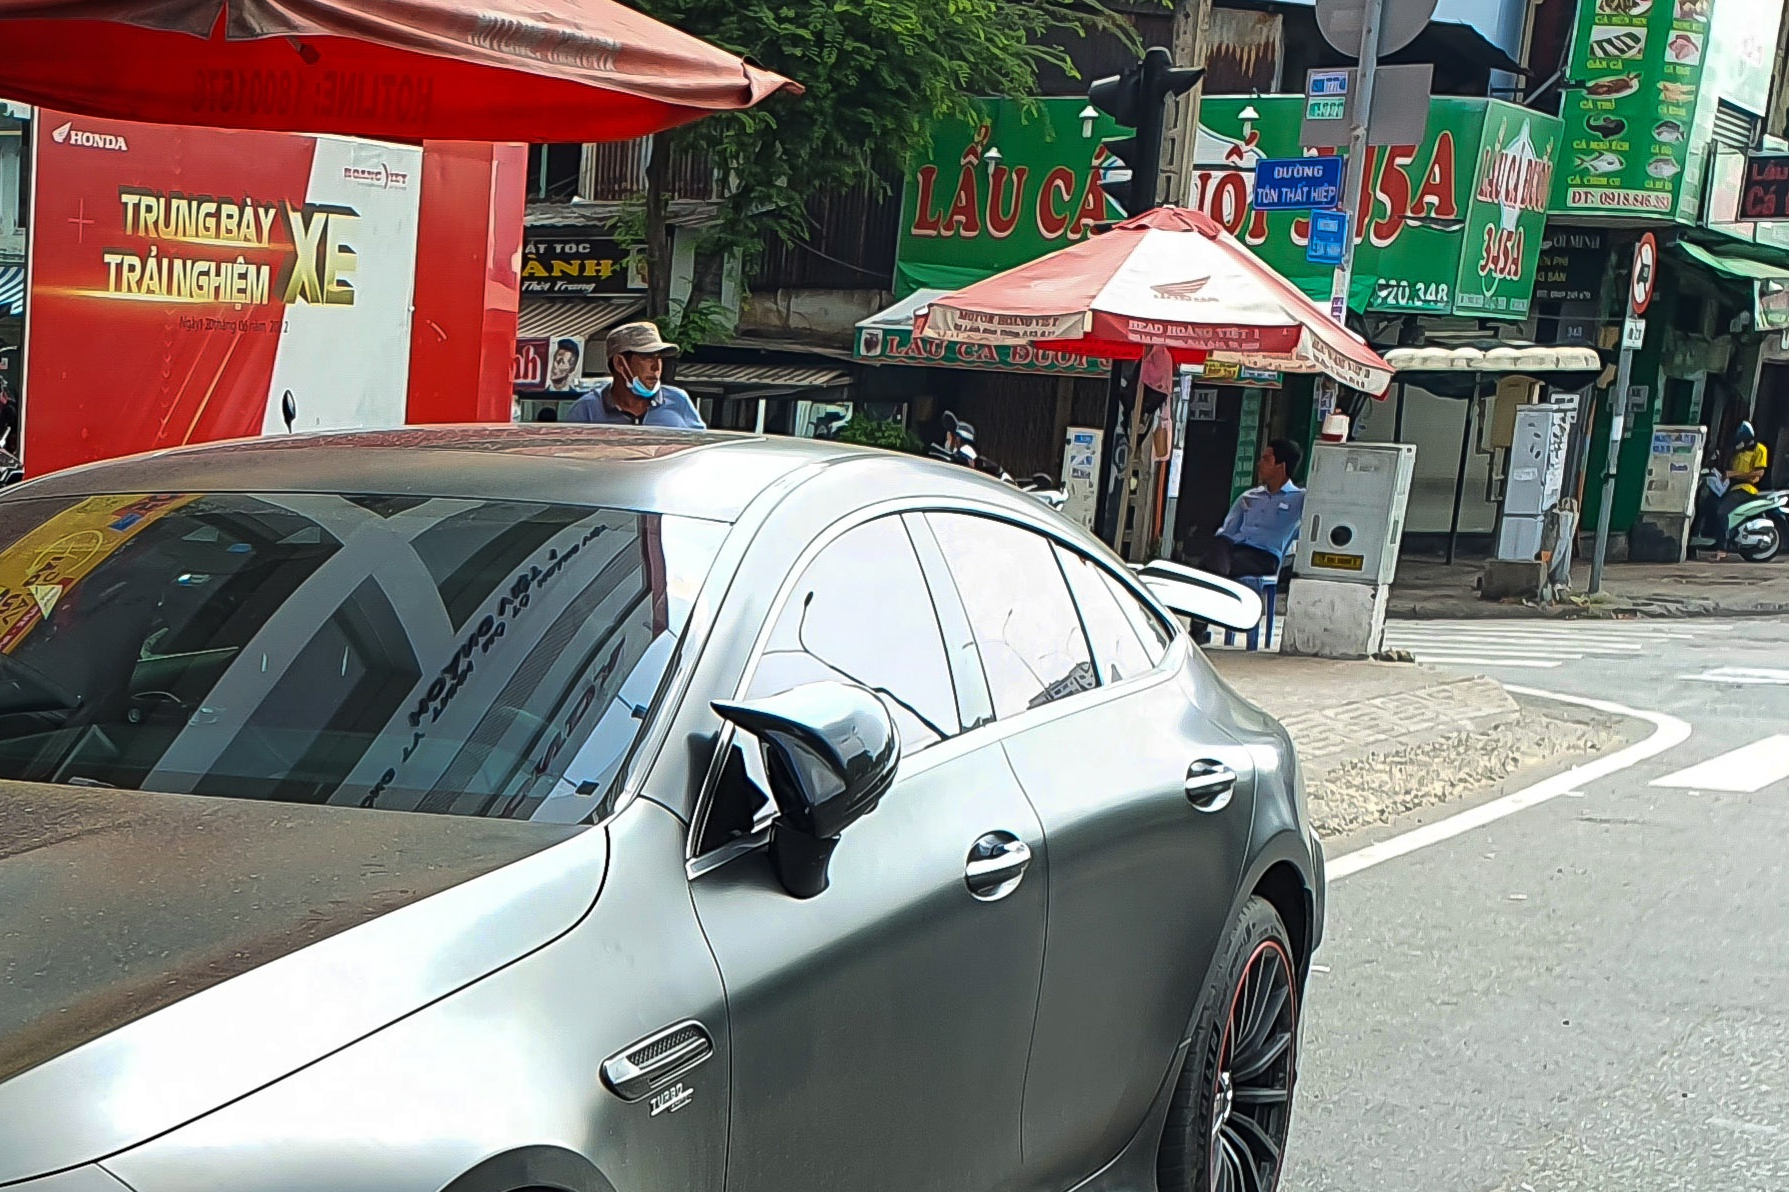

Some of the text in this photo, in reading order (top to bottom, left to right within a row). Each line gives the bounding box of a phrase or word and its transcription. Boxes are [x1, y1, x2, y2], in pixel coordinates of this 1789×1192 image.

[69, 128, 128, 153] HONDA
[911, 123, 1030, 241] LẨU
[1256, 181, 1336, 205] TÔN THẤT HIỆP
[119, 193, 362, 306] TRƯNG BÀY XE
[102, 244, 270, 311] TRẢI NGHIỆM
[521, 253, 615, 279] ÀNH
[650, 1081, 684, 1112] TURBO
